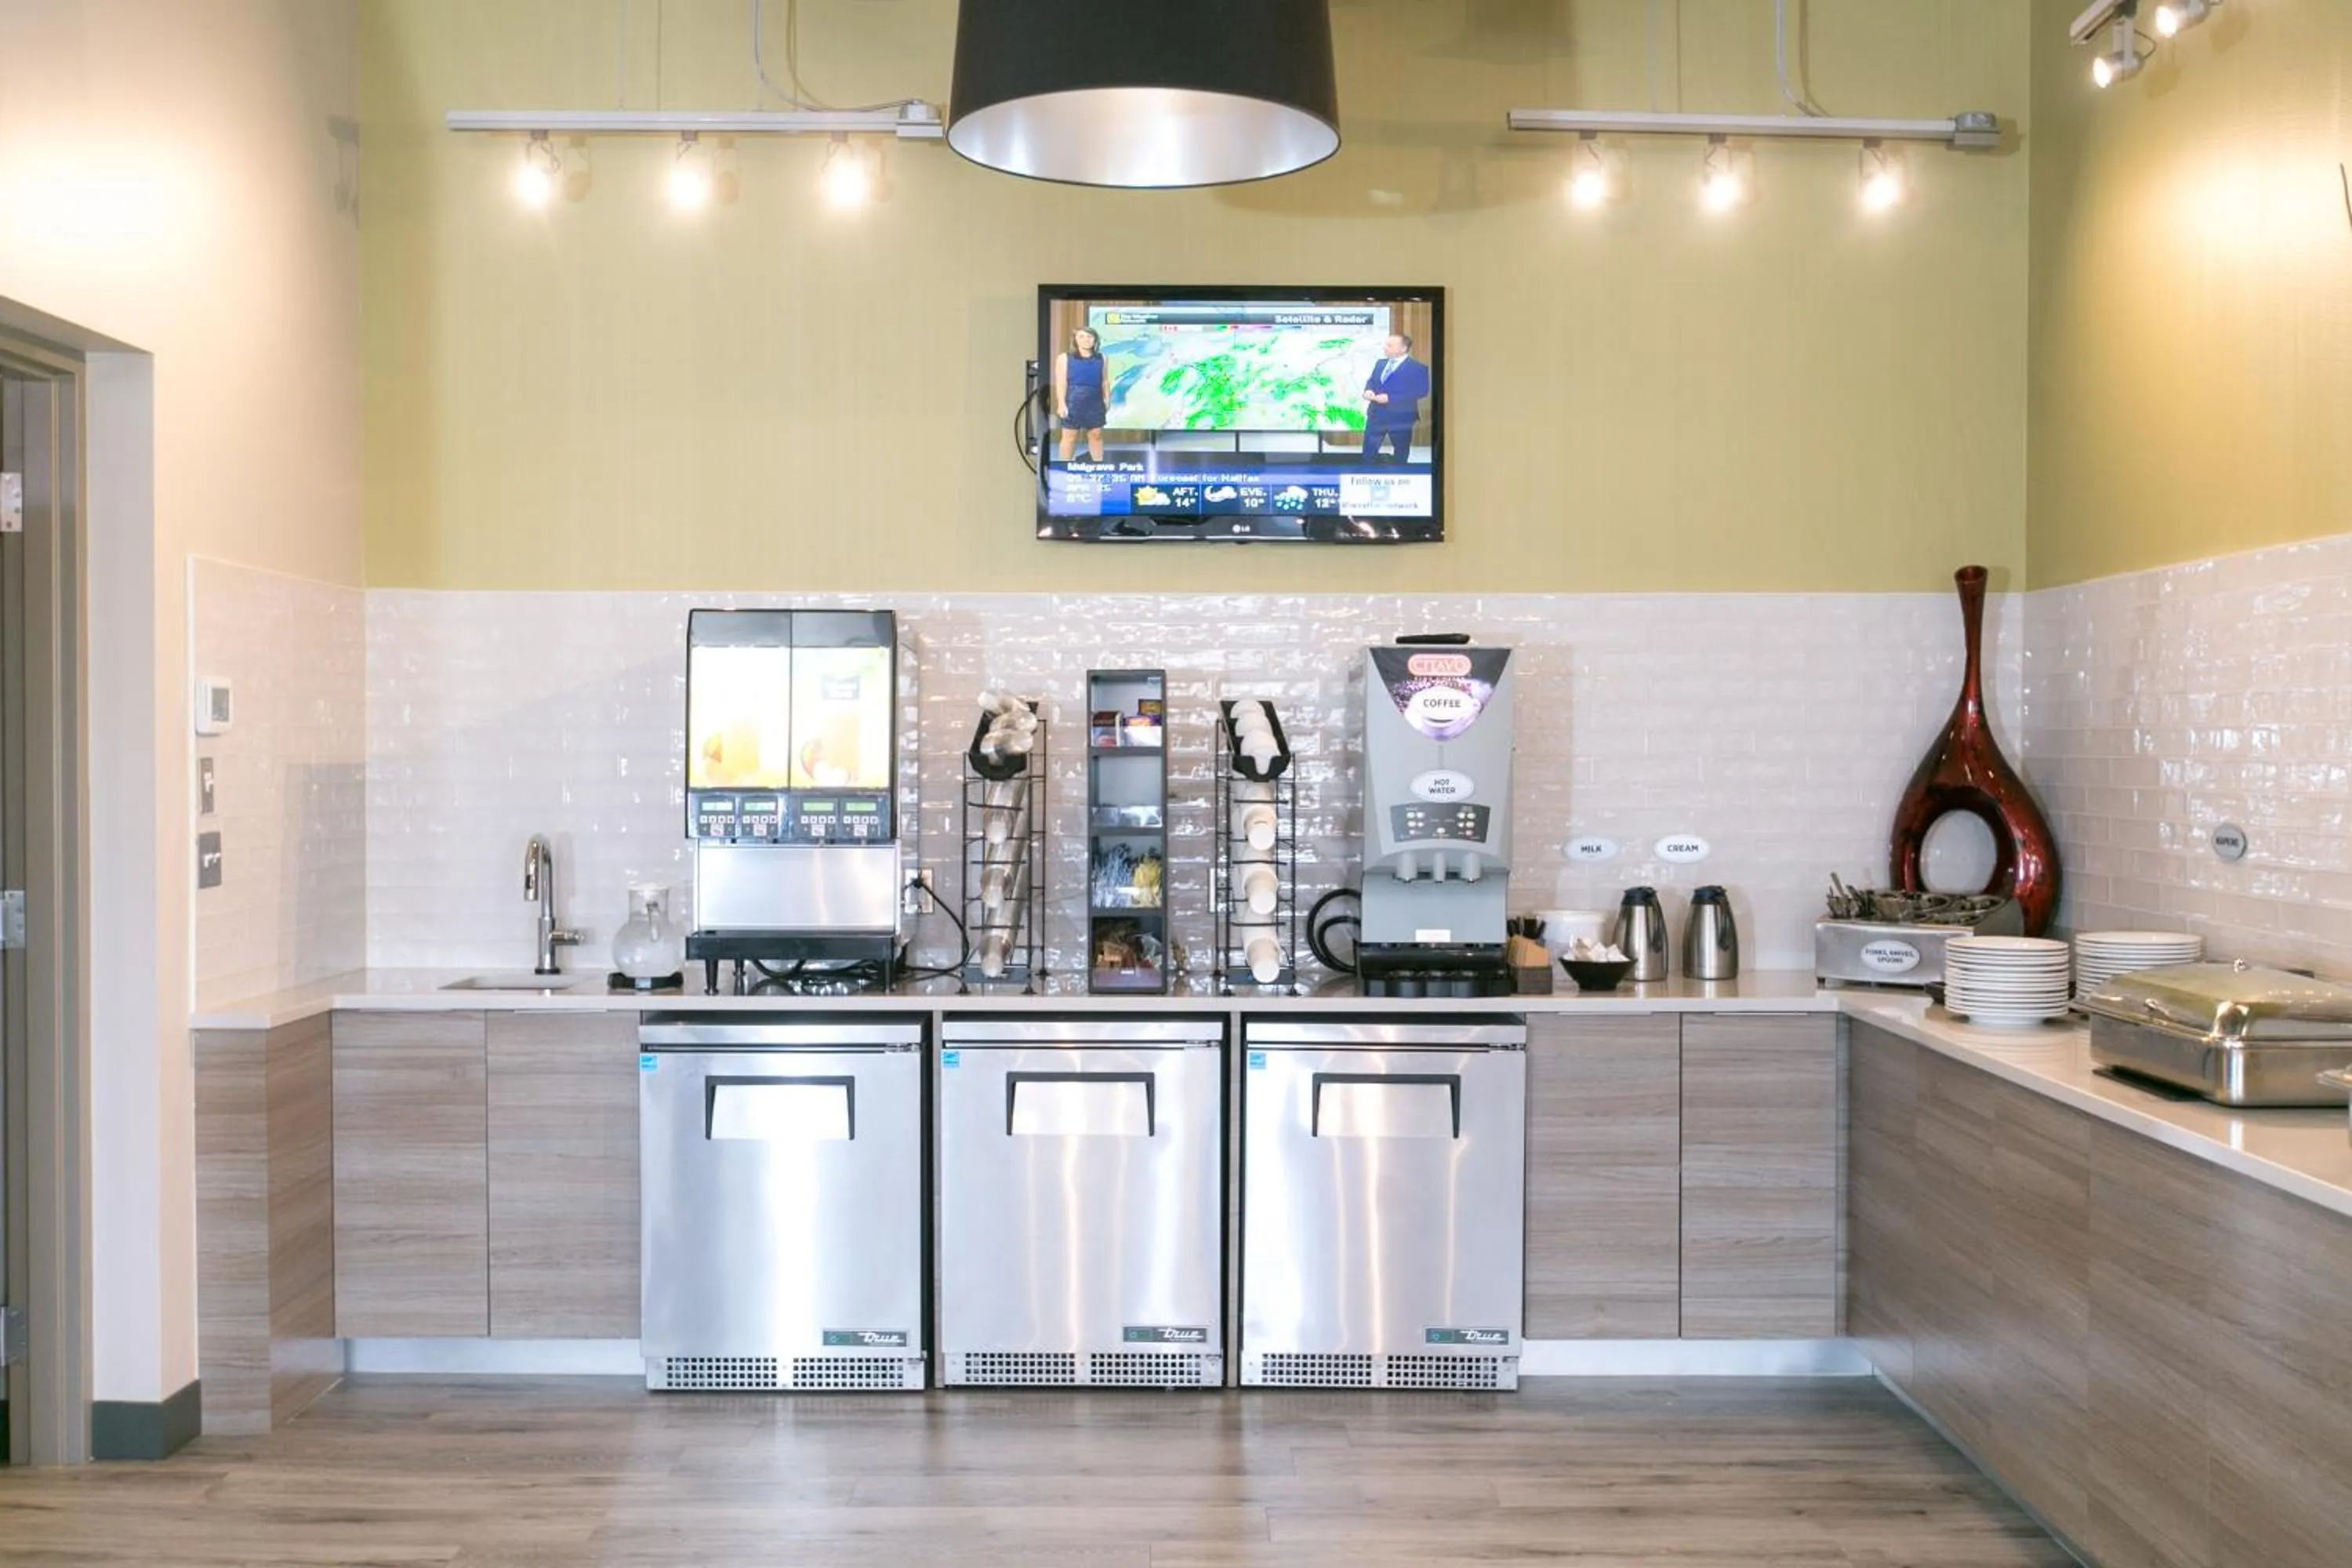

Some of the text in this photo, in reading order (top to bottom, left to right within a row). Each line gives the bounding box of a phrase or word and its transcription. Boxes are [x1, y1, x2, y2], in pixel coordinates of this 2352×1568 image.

[1275, 314, 1321, 324] Satellite
[1334, 315, 1368, 324] Radar
[1120, 463, 1143, 471] Park
[1173, 488, 1199, 496] AFT.
[1240, 488, 1267, 496] EVE.
[1312, 488, 1338, 497] THU.
[1176, 498, 1196, 507] 14°
[1244, 498, 1265, 508] 10°
[1423, 699, 1461, 708] COFFEE
[1581, 844, 1602, 853] MILK
[1158, 1327, 1204, 1339] True
[1459, 1330, 1505, 1341] True
[857, 1332, 904, 1344] True
